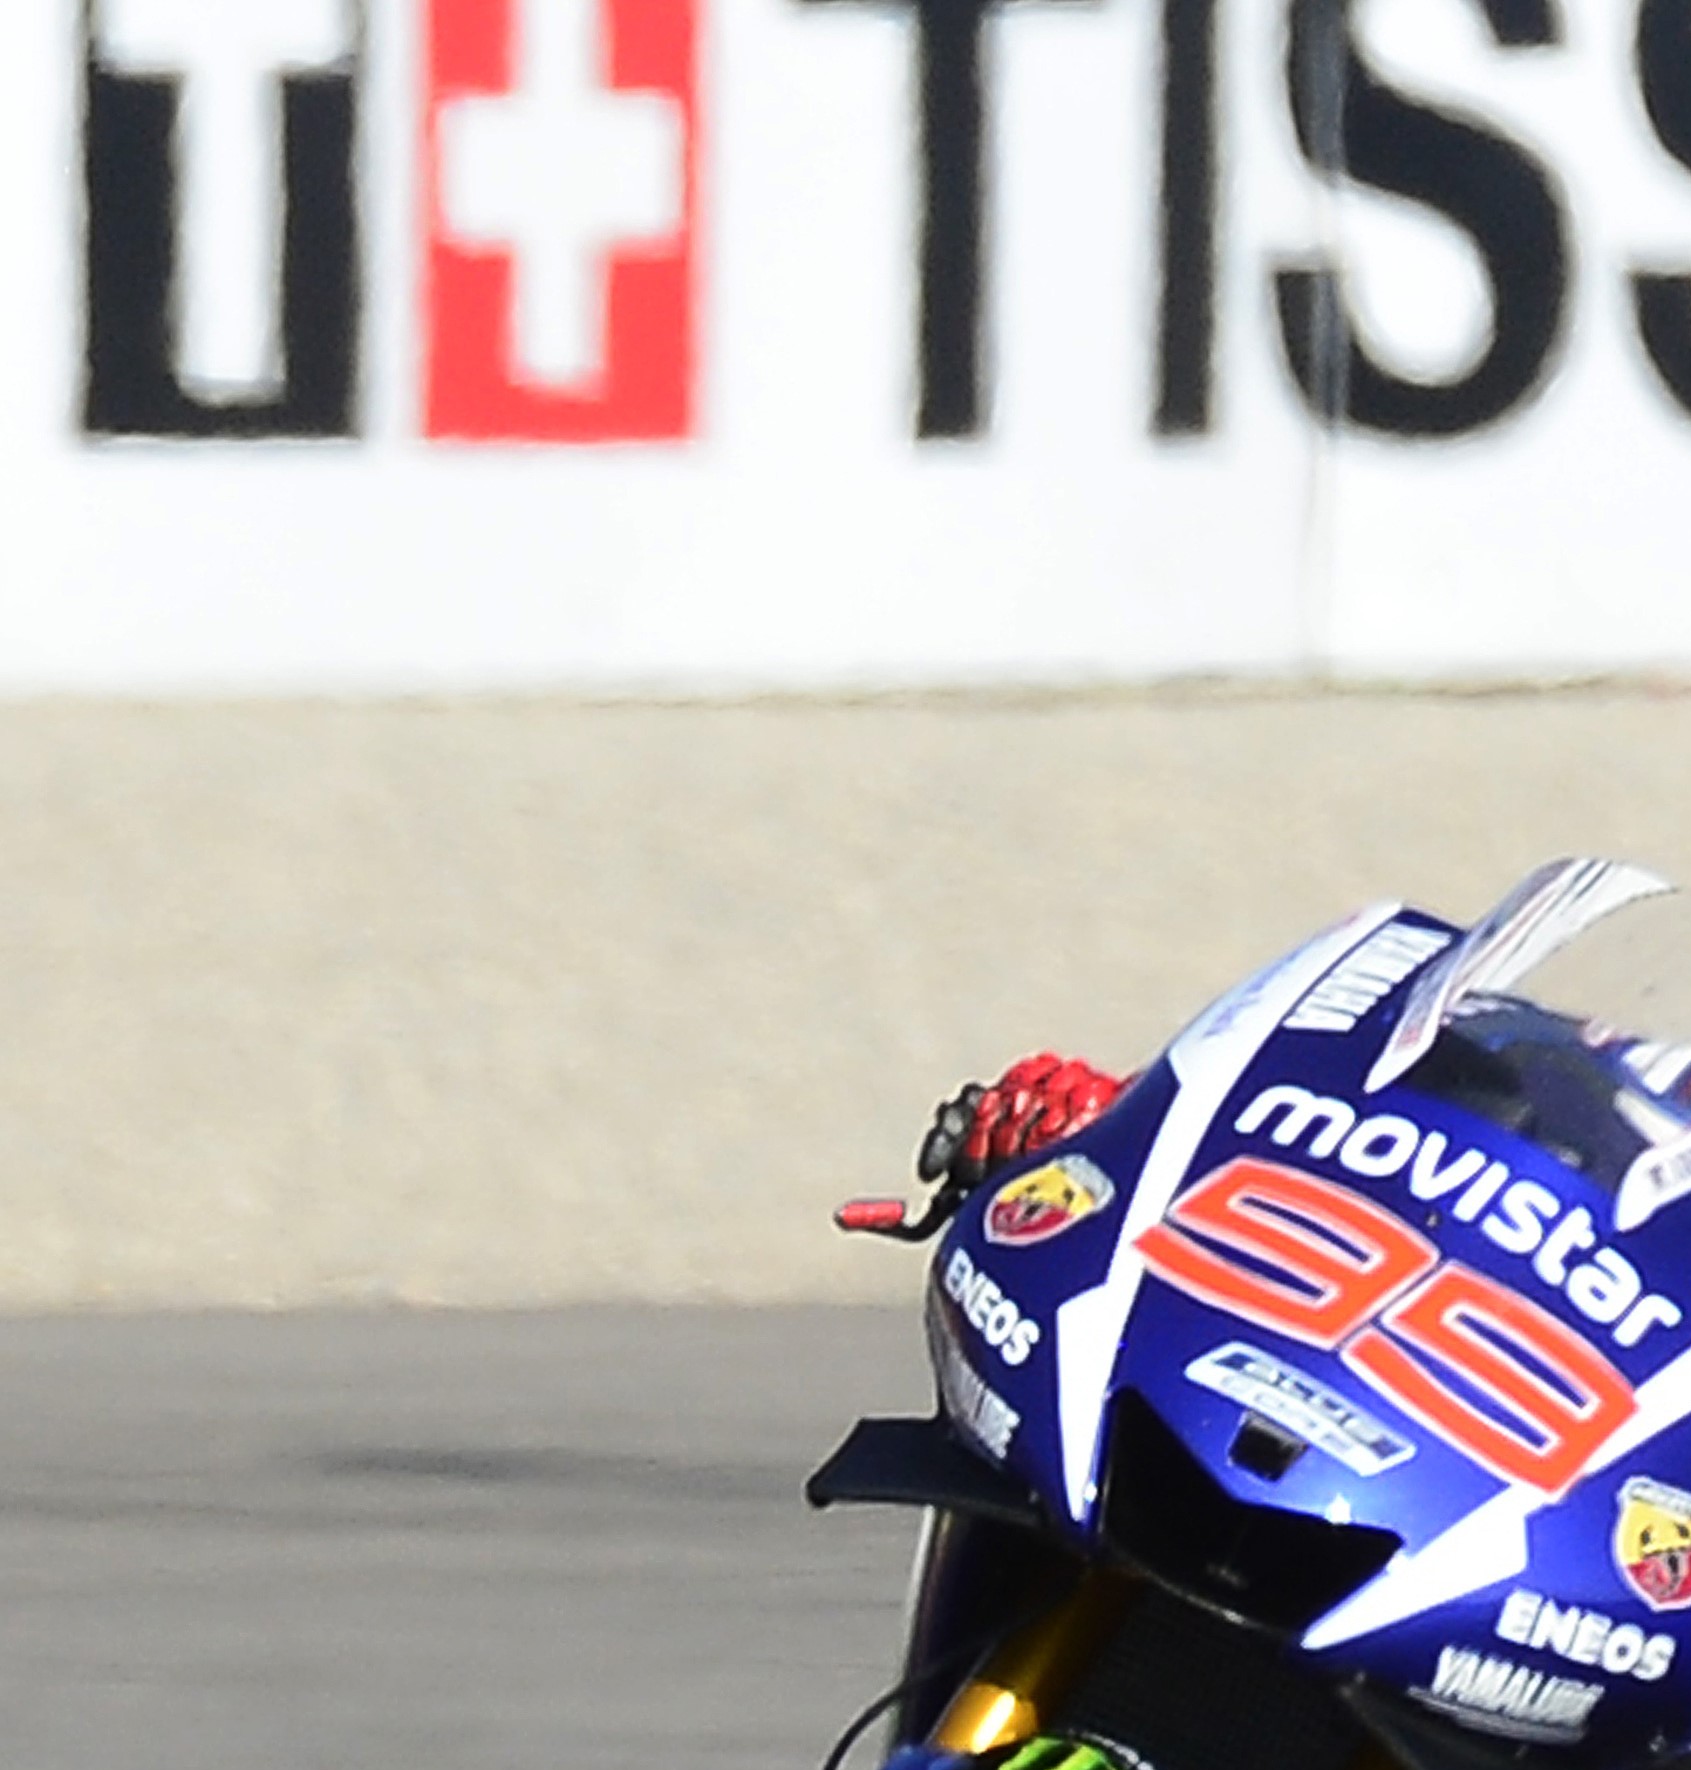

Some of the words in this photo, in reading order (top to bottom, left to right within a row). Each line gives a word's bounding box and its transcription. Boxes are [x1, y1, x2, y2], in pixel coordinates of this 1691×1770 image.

[946, 1247, 1041, 1366] ENEOS
[1234, 1083, 1683, 1348] movistar
[1130, 1155, 1642, 1497] 99
[1495, 1587, 1676, 1681] ENEOS
